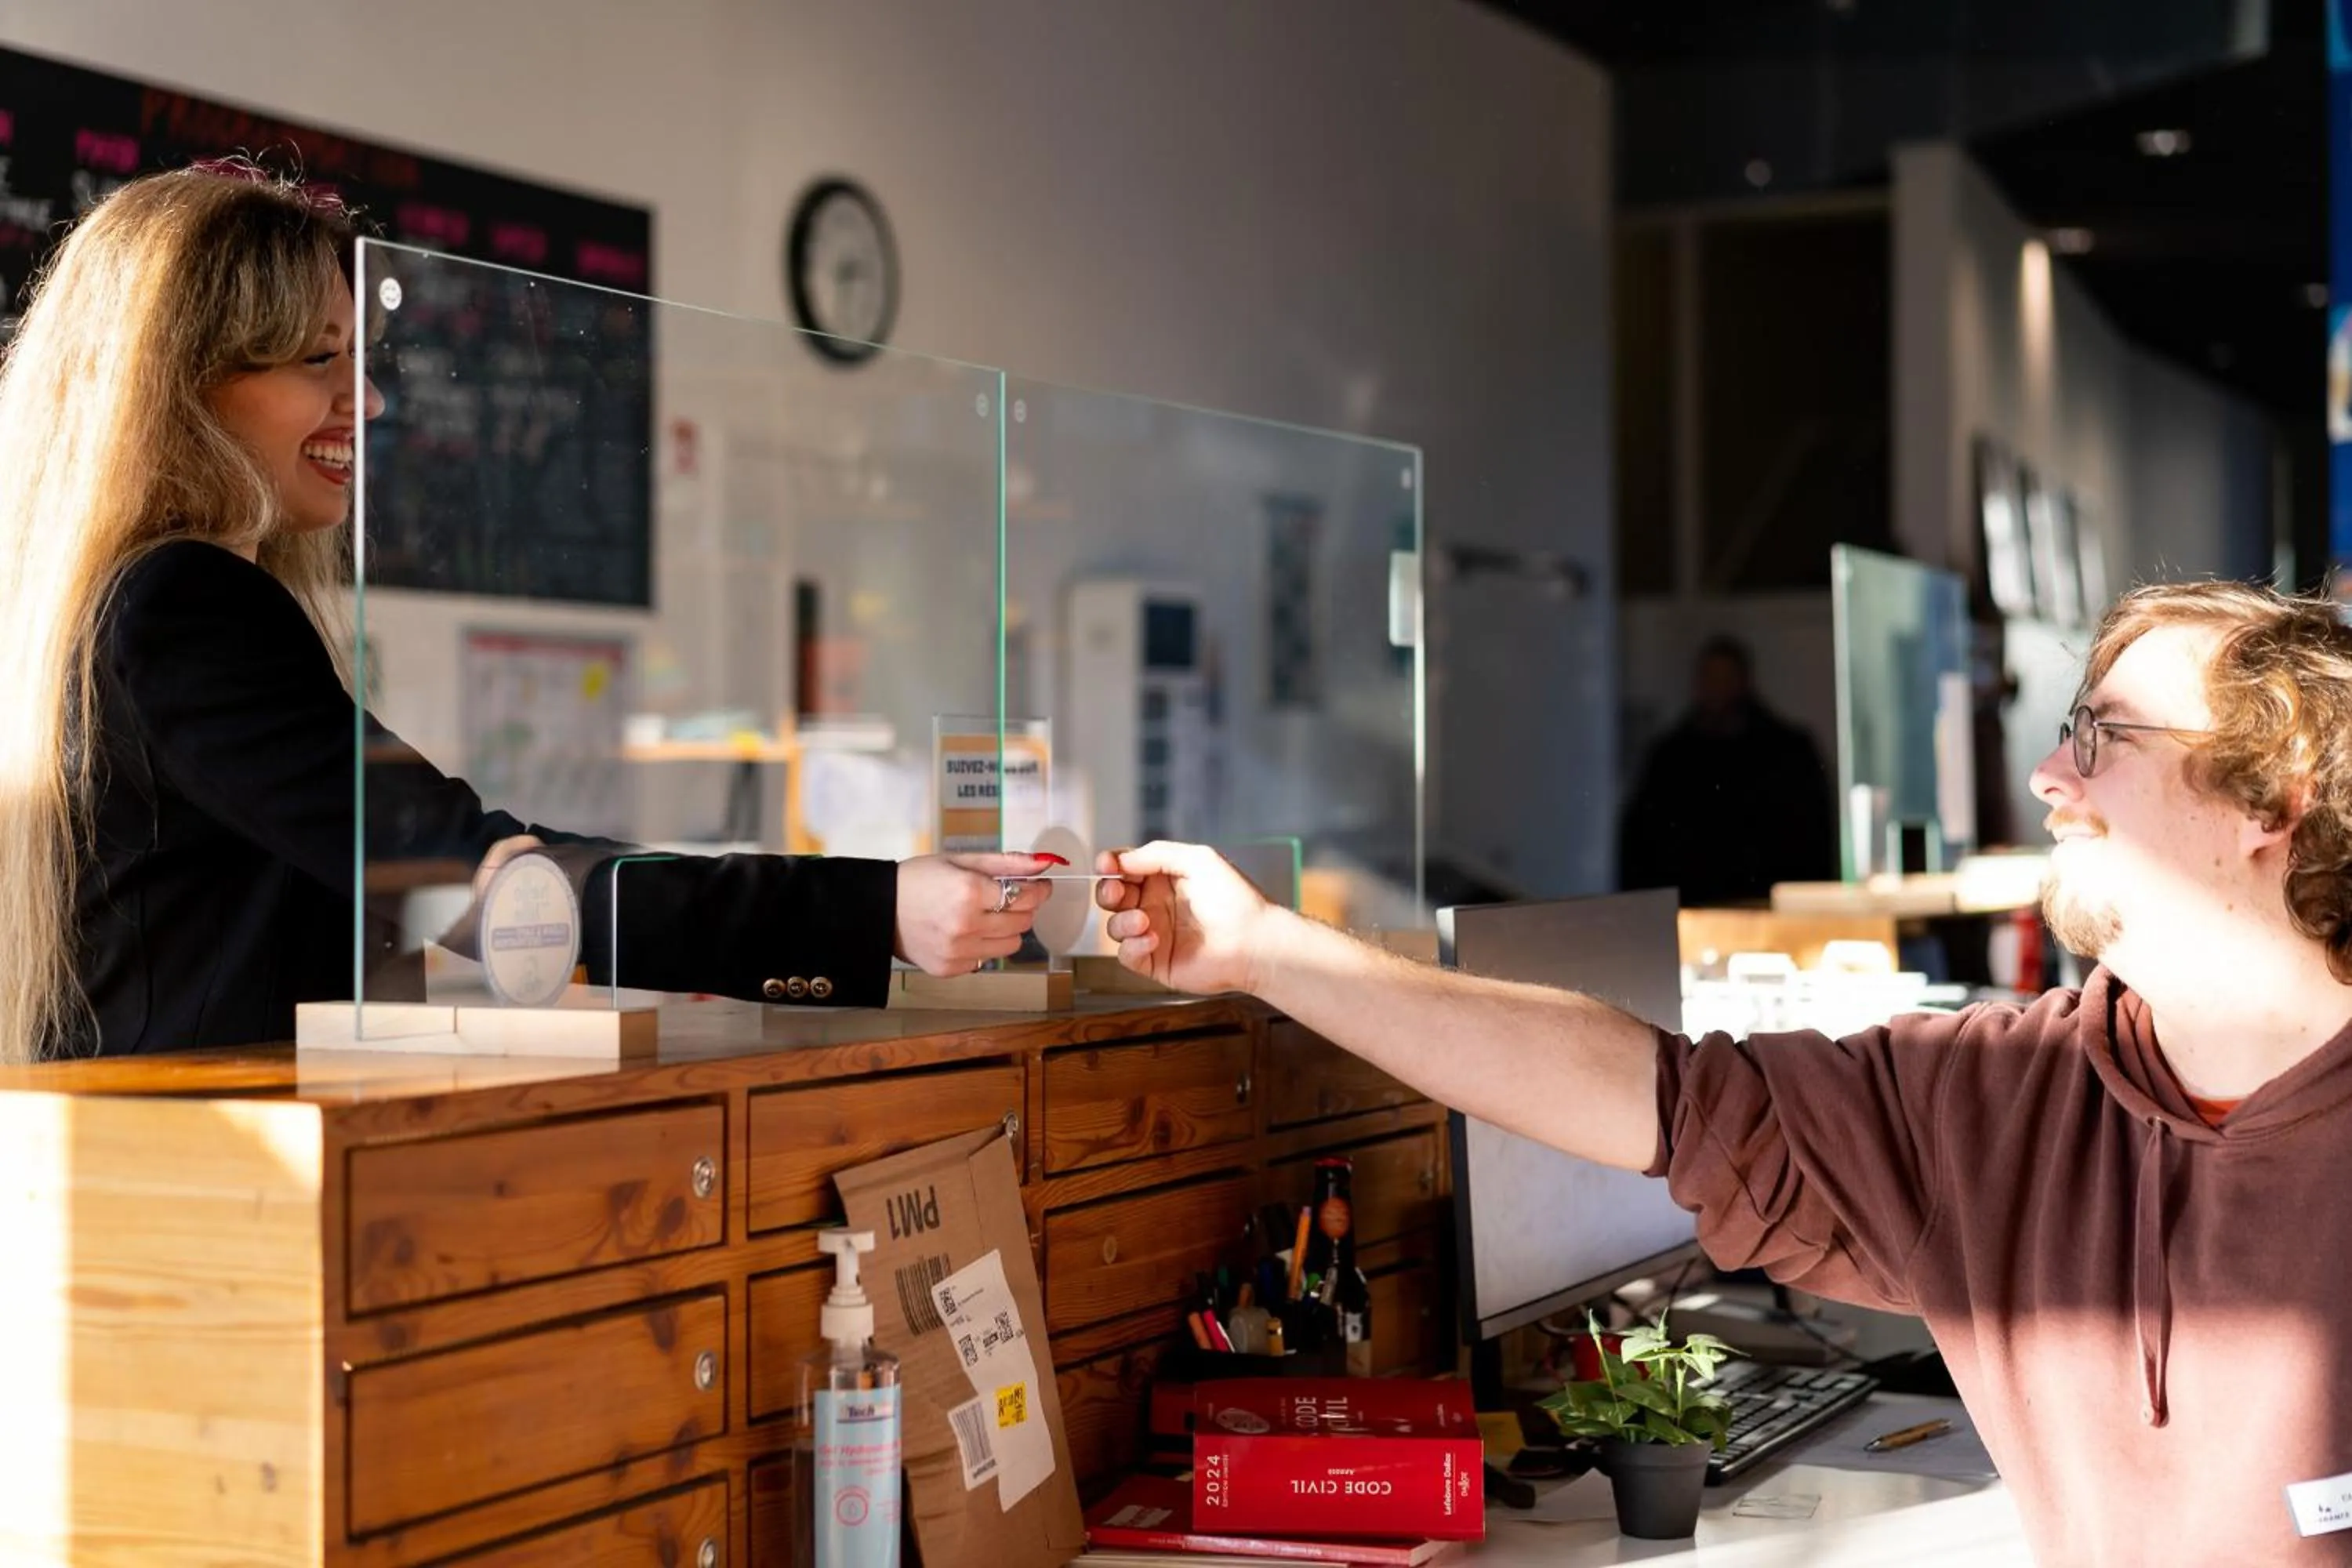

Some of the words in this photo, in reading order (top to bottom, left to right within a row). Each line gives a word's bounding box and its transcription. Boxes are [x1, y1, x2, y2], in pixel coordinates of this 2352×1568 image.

[946, 759, 1017, 774] SUIVEZ-N
[886, 1185, 940, 1241] PM1
[1295, 1397, 1318, 1428] CODE
[1207, 1454, 1220, 1506] 2024
[1290, 1479, 1338, 1494] CIVIL
[1345, 1480, 1392, 1495] CODE
